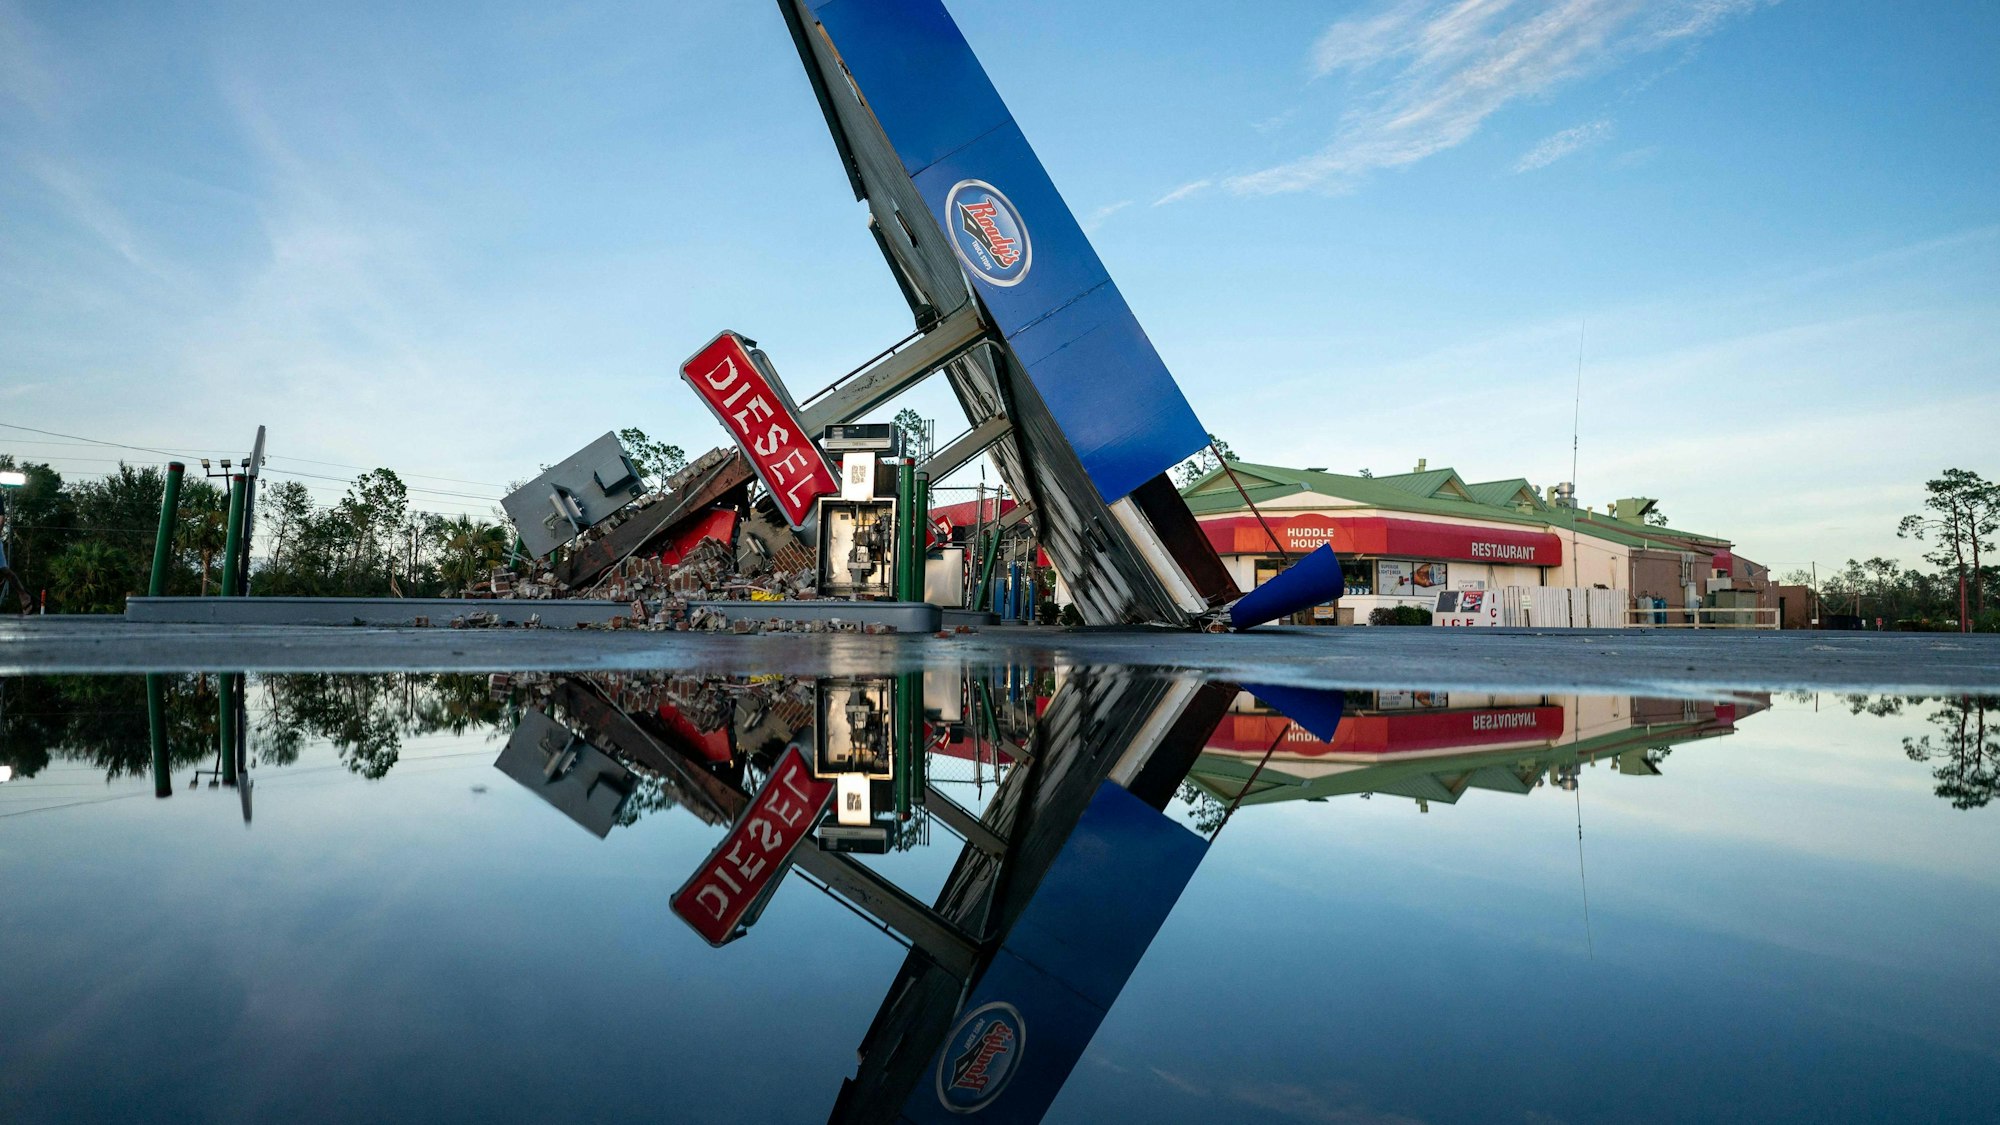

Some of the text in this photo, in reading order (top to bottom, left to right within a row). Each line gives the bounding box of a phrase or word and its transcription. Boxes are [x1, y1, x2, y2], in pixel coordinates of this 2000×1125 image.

[965, 197, 1020, 266] Roady's
[972, 240, 992, 271] TRUCK STOPS
[705, 355, 816, 509] DIESEL
[1287, 528, 1334, 537] HUDDLE
[1471, 542, 1535, 560] RESTAURANT
